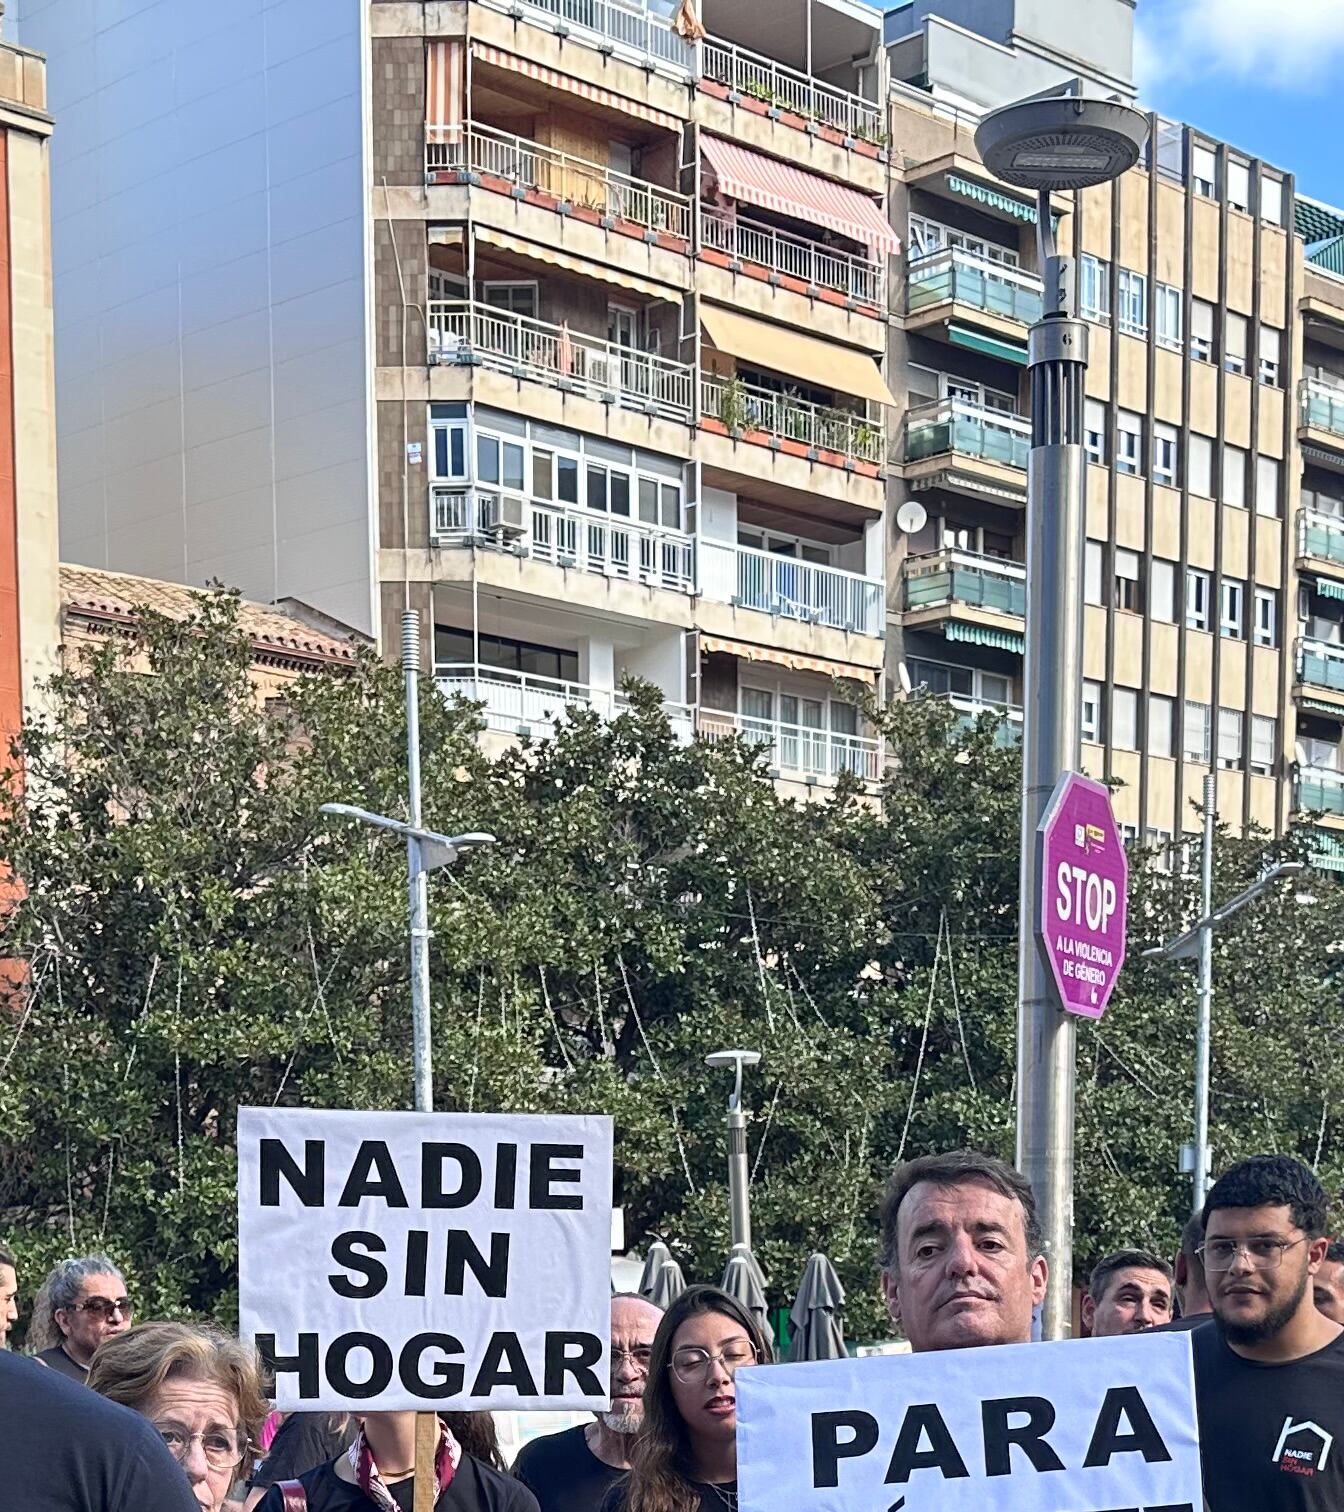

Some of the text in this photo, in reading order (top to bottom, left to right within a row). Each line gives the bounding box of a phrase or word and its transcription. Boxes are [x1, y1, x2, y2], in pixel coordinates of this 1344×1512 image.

[1056, 861, 1116, 934] STOP
[1056, 935, 1113, 967] A LA VIOLENCIA
[1063, 958, 1106, 987] DE GÉNERO
[259, 1139, 584, 1211] NADIE
[328, 1230, 510, 1299] SIN
[255, 1331, 606, 1400] HOGAR
[811, 1385, 1172, 1489] PARA
[1284, 1448, 1313, 1461] NADIE
